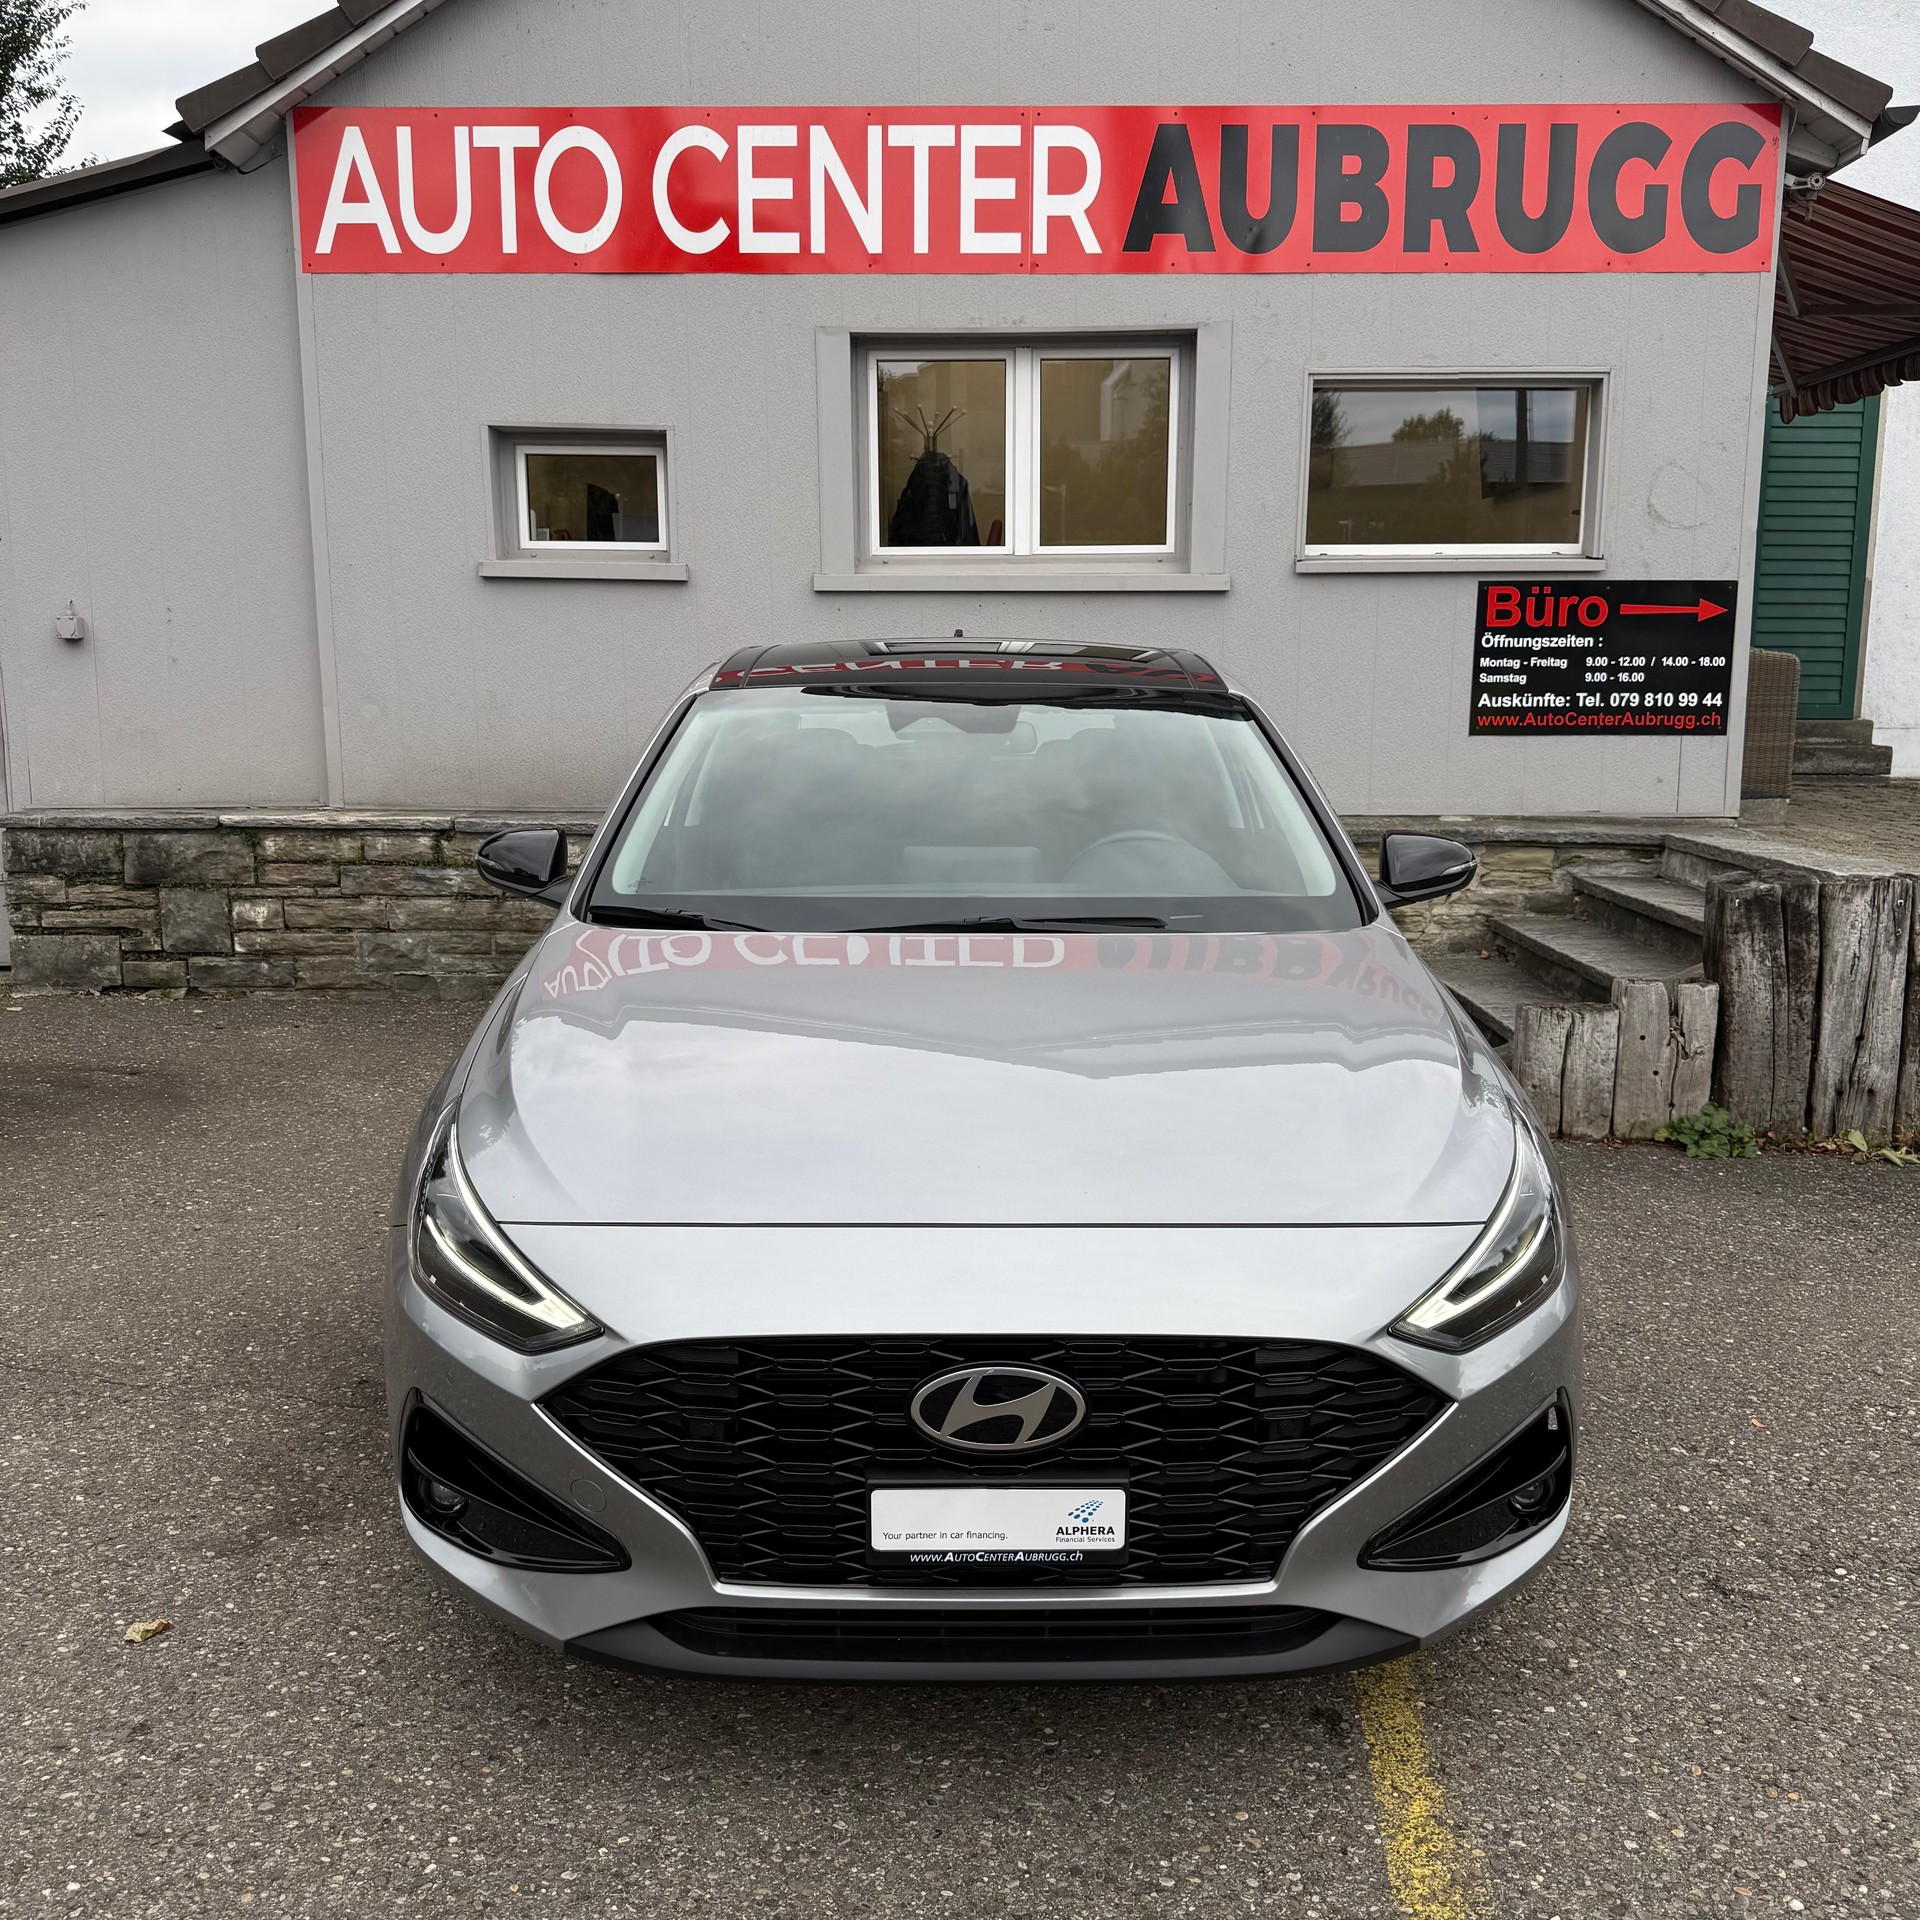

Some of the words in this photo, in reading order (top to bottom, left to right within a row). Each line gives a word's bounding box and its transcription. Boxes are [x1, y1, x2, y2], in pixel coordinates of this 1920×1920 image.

[315, 124, 623, 256] AUTO
[652, 124, 1102, 256] CENTER
[1121, 121, 1767, 255] AUBRUGG
[1486, 586, 1609, 628] Büro
[1481, 632, 1594, 650] Öffnungszeiten
[1479, 657, 1521, 669] Montag
[1530, 656, 1568, 669] Freitag
[1585, 656, 1608, 667] 9.00
[1619, 656, 1646, 667] 12.00
[1661, 656, 1689, 667] 14.00
[1699, 656, 1726, 667] 18.00
[1479, 672, 1527, 685] Samstag
[1584, 672, 1608, 683] 9.00
[1617, 672, 1645, 683] 16.00
[1477, 692, 1571, 708] Auskünfte:
[1576, 692, 1605, 708] Tel.
[1609, 692, 1639, 708] 079
[1644, 692, 1674, 708] 810
[1678, 692, 1698, 708] 99
[1702, 692, 1723, 708] 44
[1477, 711, 1721, 730] www.AutoCenterAubrugg.ch
[883, 1531, 903, 1541] Your
[905, 1531, 937, 1542] partner
[939, 1530, 948, 1540] in
[950, 1531, 964, 1540] car
[966, 1530, 1009, 1541] financing.
[1055, 1526, 1116, 1536] ALPHERA
